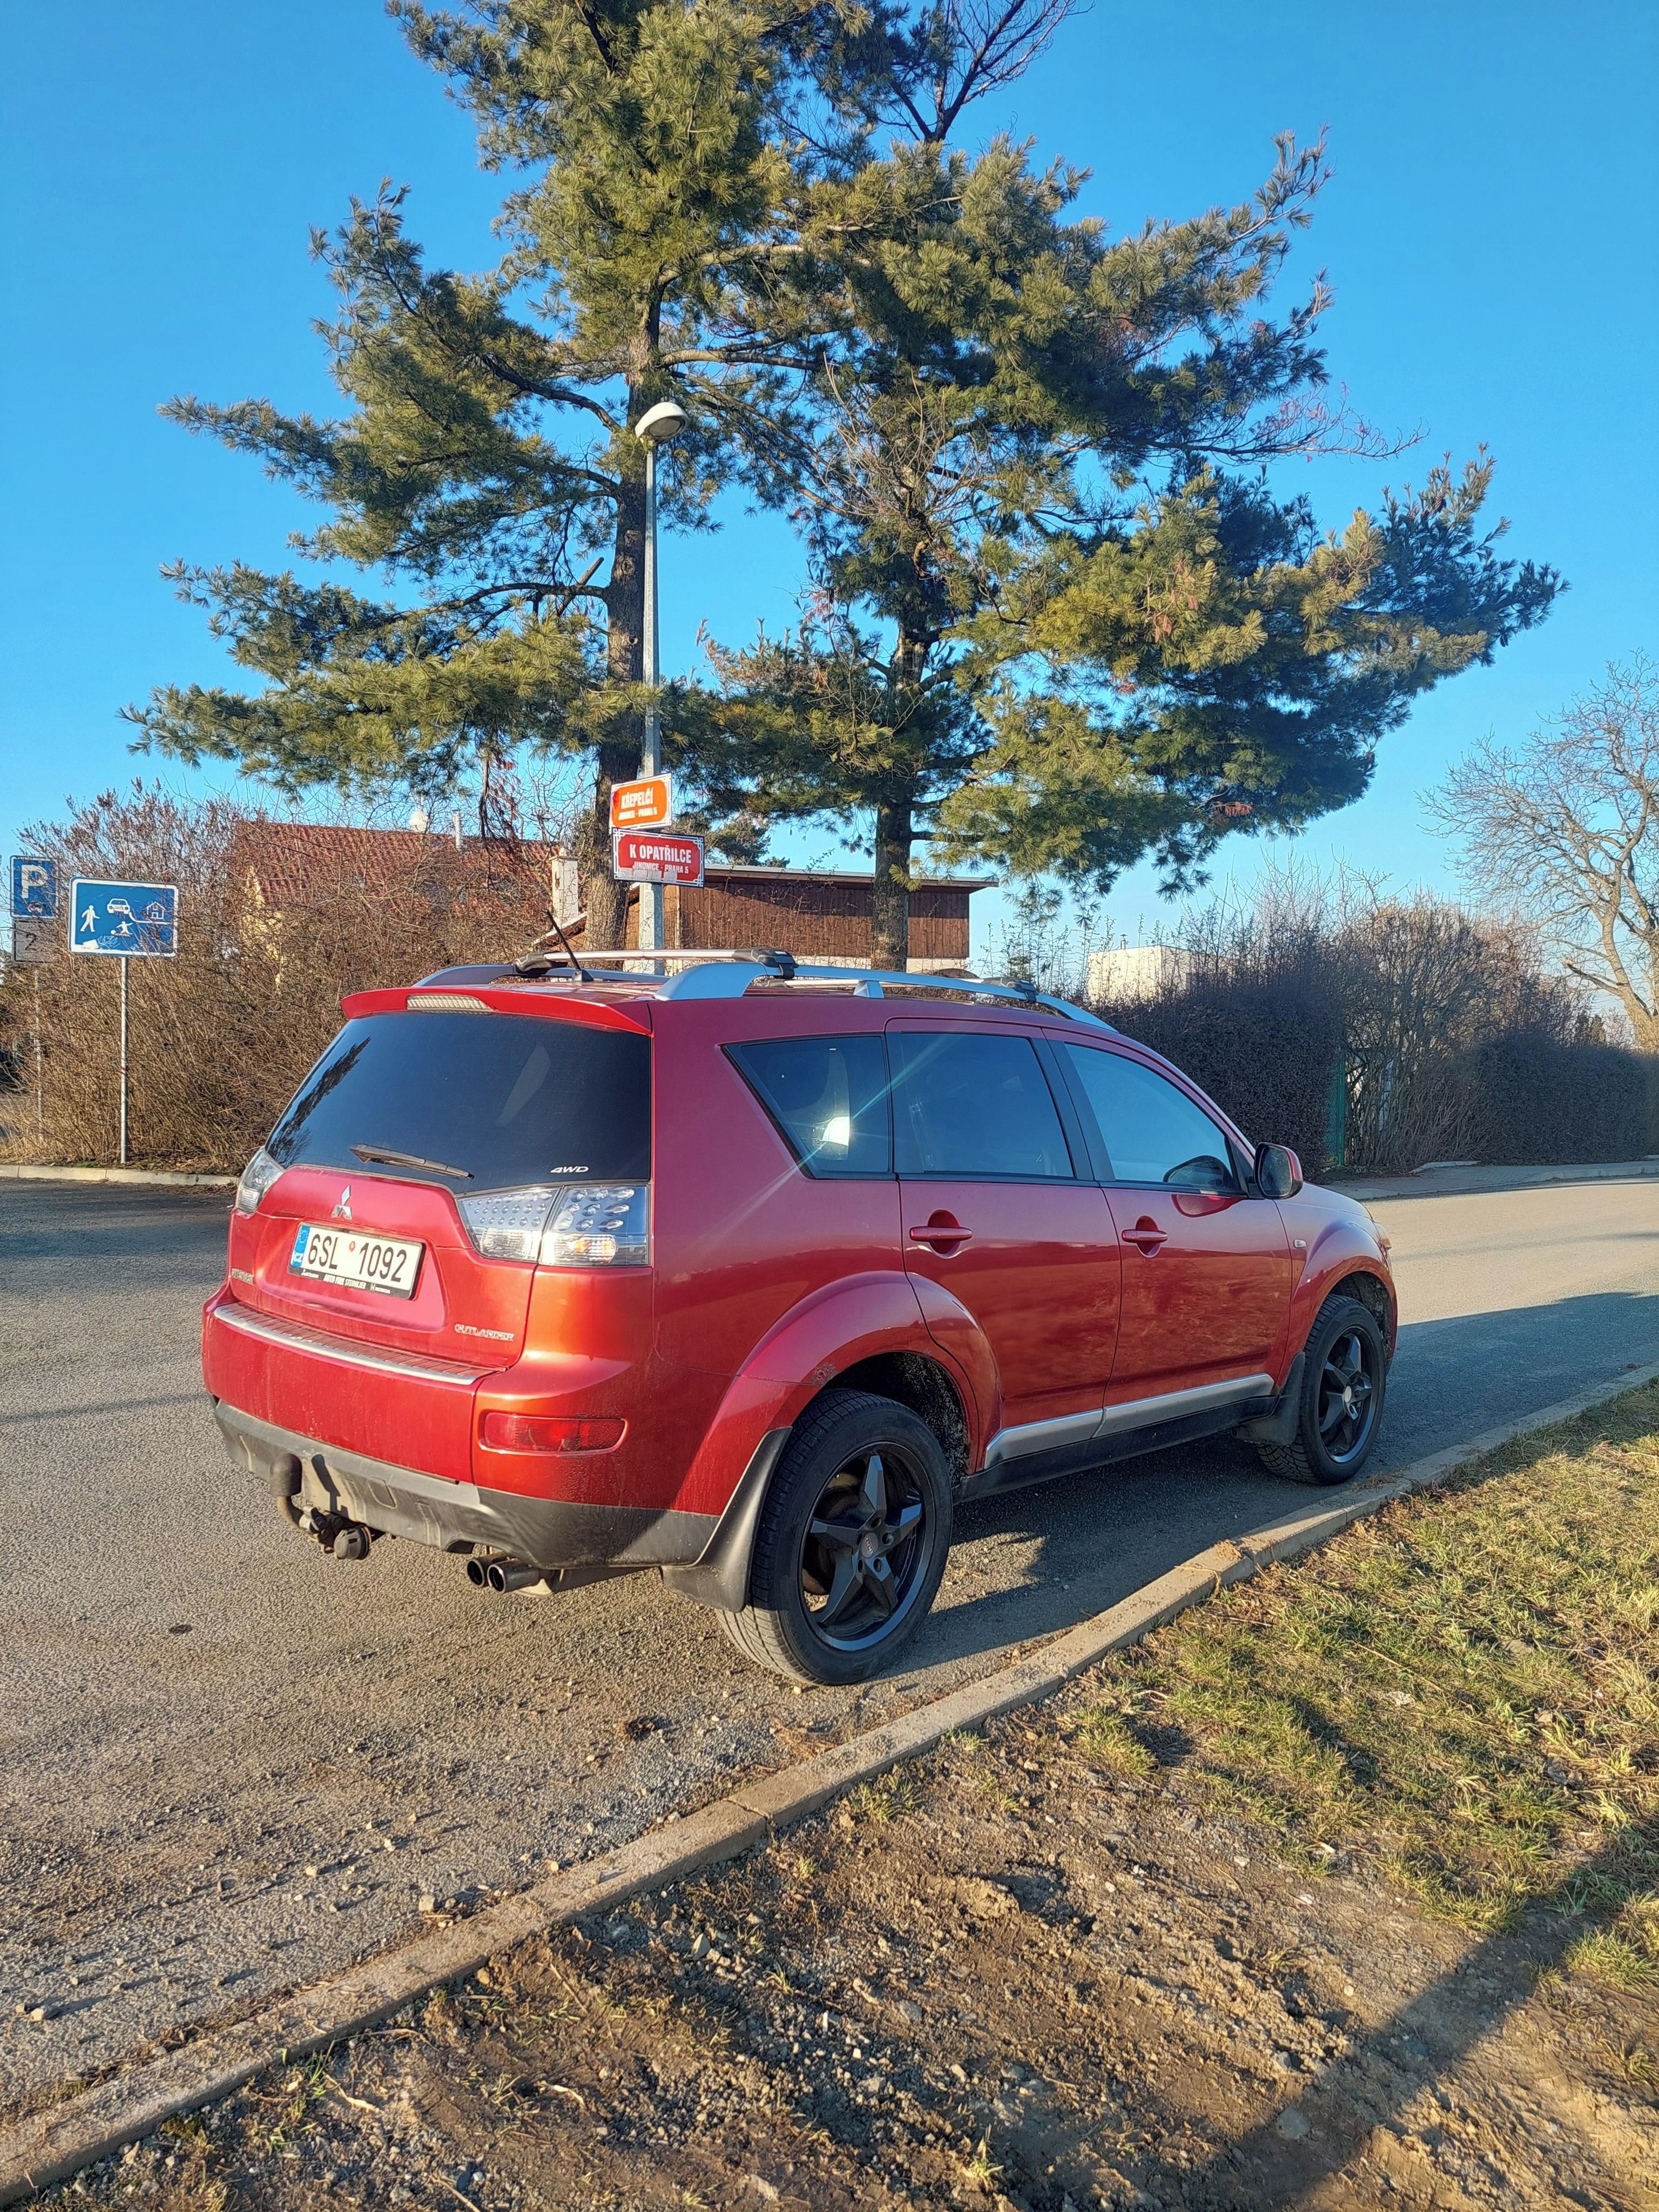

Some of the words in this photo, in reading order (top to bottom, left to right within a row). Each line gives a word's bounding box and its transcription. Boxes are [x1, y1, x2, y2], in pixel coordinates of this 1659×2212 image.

[629, 844, 637, 859] K
[639, 845, 692, 864] OPATŘILCE
[632, 861, 659, 871] JINONICE
[664, 864, 683, 873] PRAHA
[22, 865, 48, 899] P
[293, 1252, 304, 1263] CZ
[308, 1233, 339, 1270] 6SL
[359, 1242, 407, 1283] 1092
[454, 1323, 515, 1342] OUTLANDER
